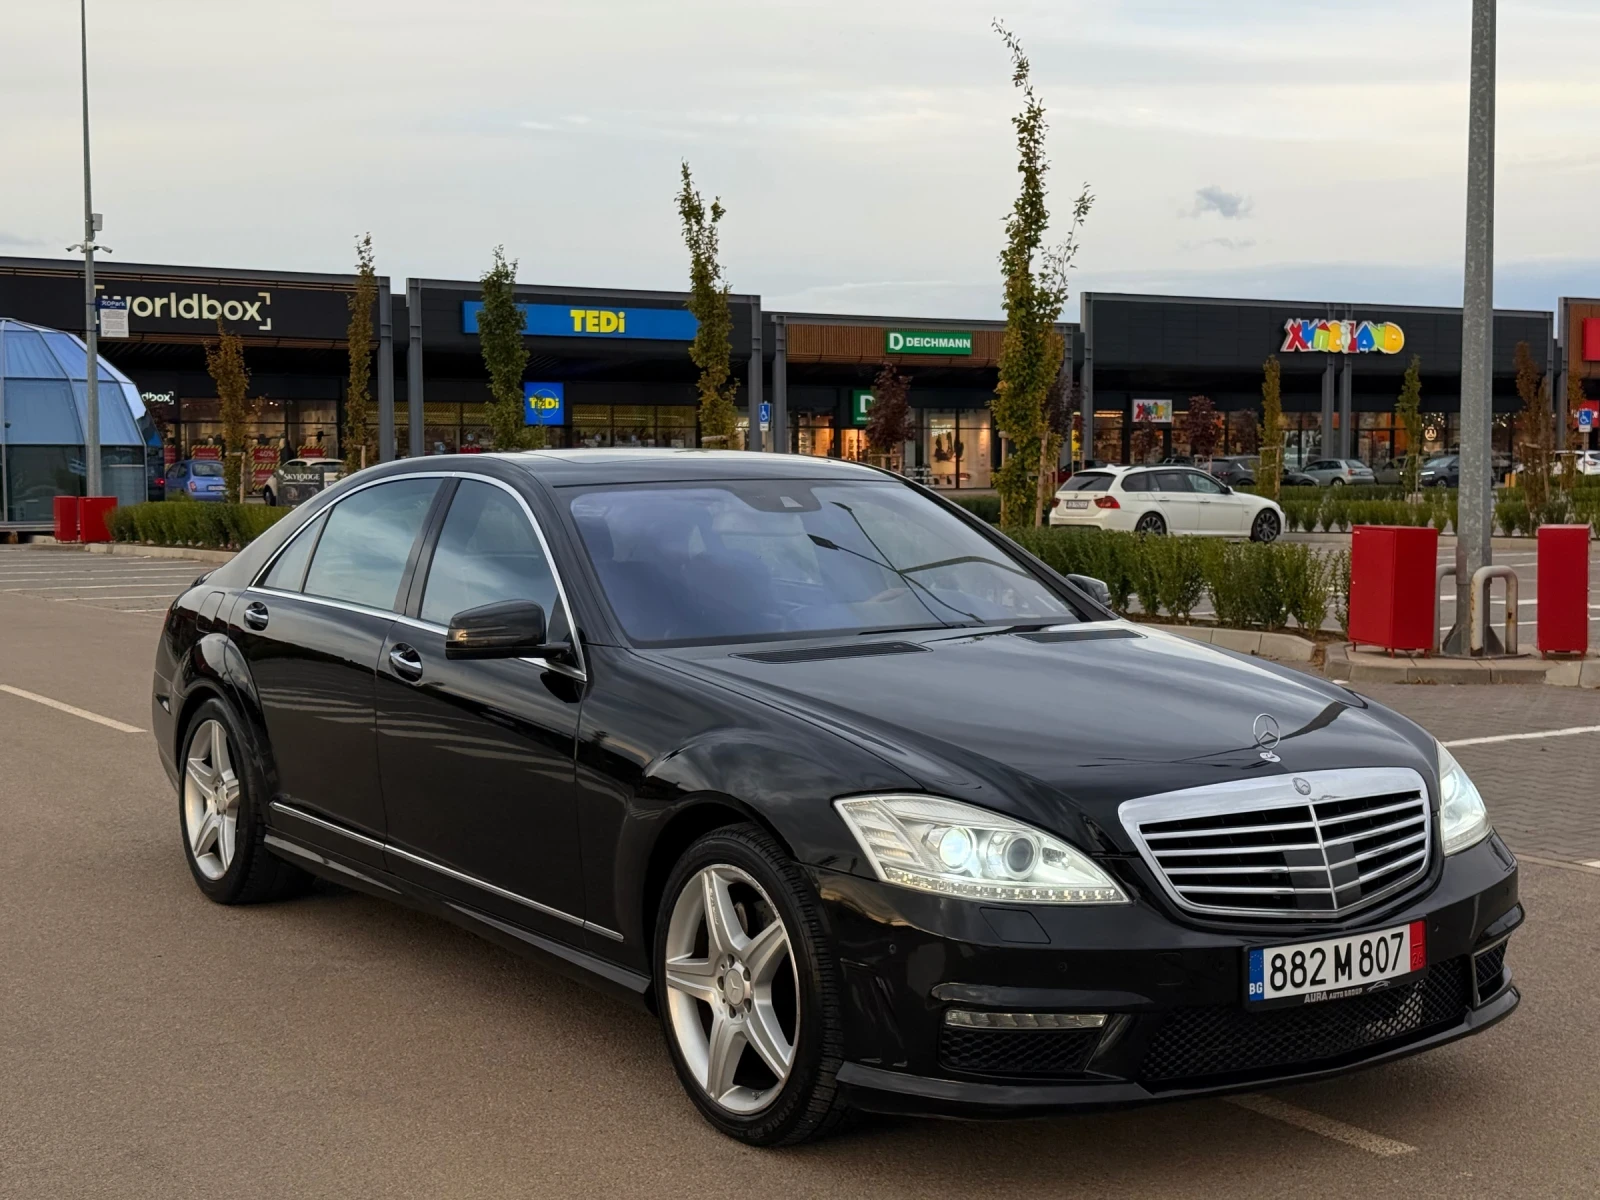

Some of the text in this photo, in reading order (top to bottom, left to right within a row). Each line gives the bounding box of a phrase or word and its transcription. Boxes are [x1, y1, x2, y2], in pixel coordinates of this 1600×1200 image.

[570, 310, 625, 333] TEDi
[889, 333, 971, 351] D DEICHMANN
[141, 392, 171, 402] dbox
[283, 473, 321, 482] SKYLODGE
[1249, 982, 1263, 995] BG
[1304, 987, 1363, 1004] AURA AUTO GROUP
